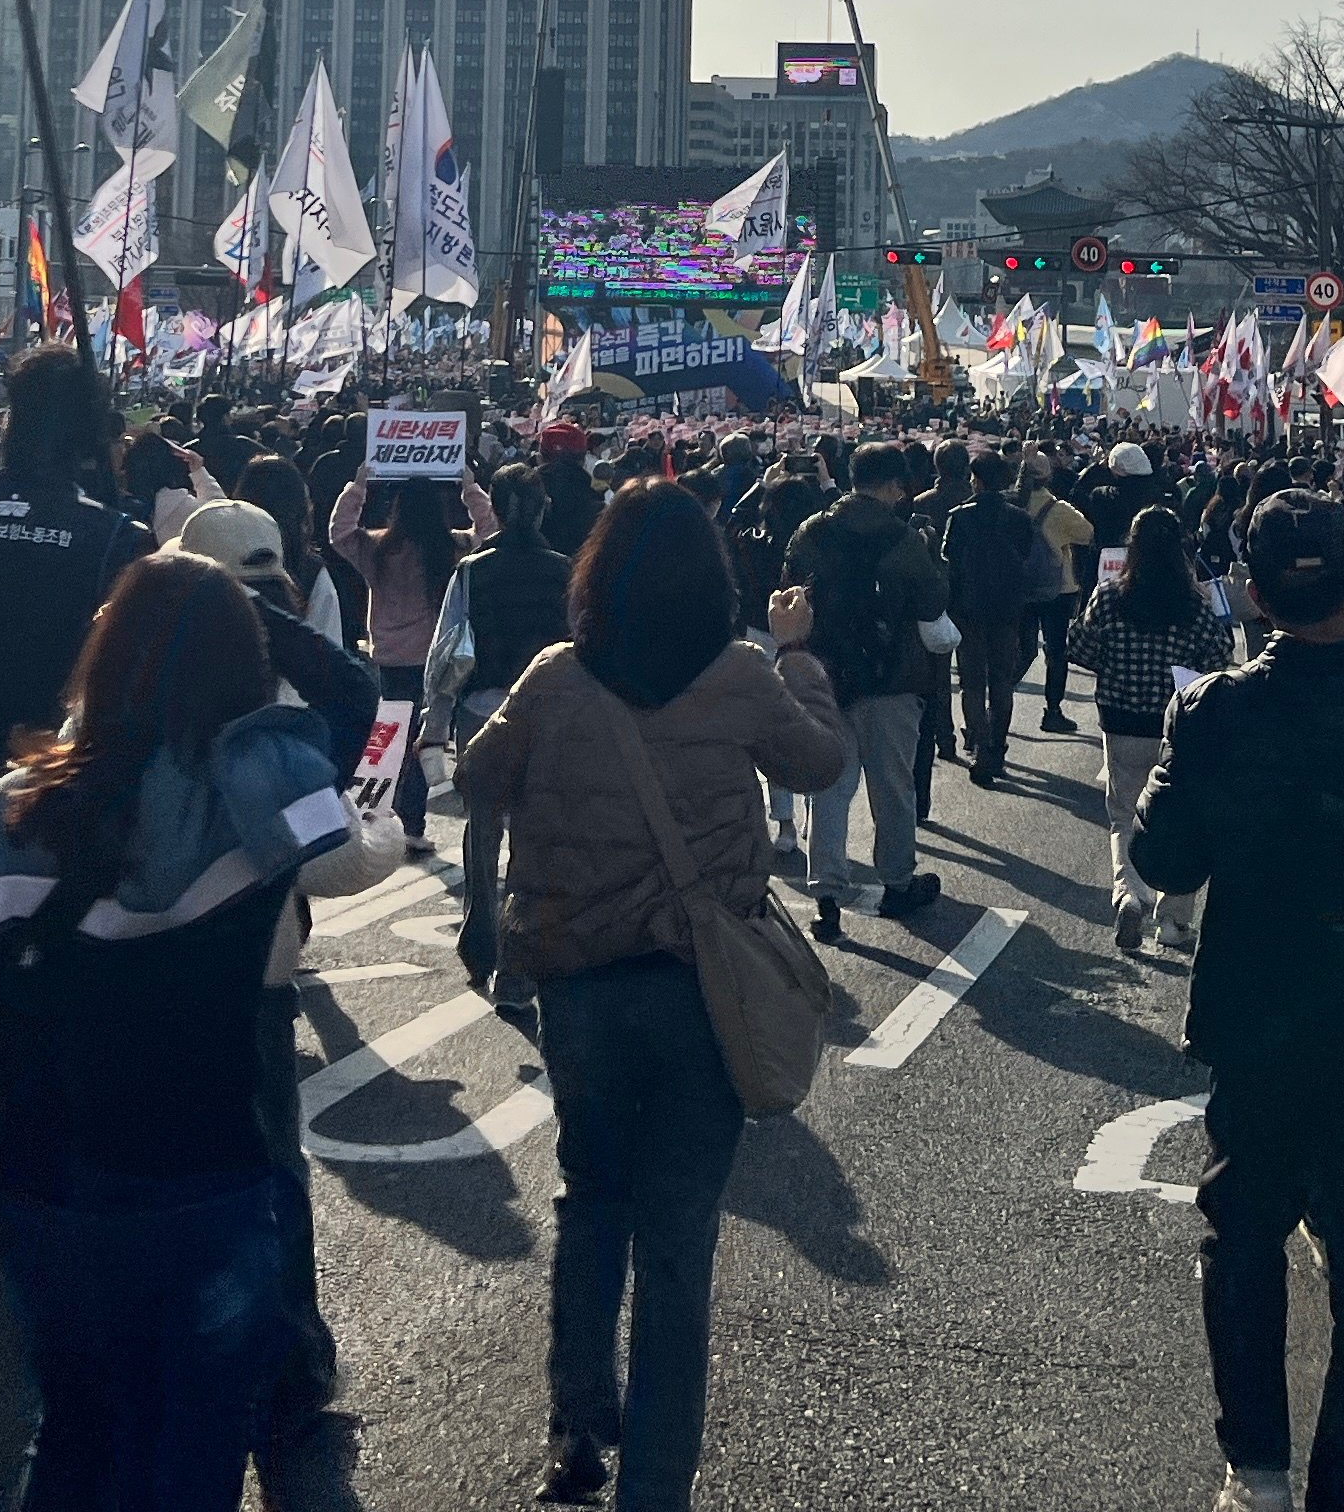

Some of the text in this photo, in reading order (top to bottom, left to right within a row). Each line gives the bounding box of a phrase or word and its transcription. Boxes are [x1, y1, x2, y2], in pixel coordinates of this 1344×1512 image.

[1078, 245, 1099, 263] 40
[1313, 283, 1335, 299] 40
[635, 319, 686, 348] 즉각
[634, 337, 744, 377] 파면하라!
[375, 419, 462, 440] 내란세력
[370, 444, 463, 465] 제압하자!
